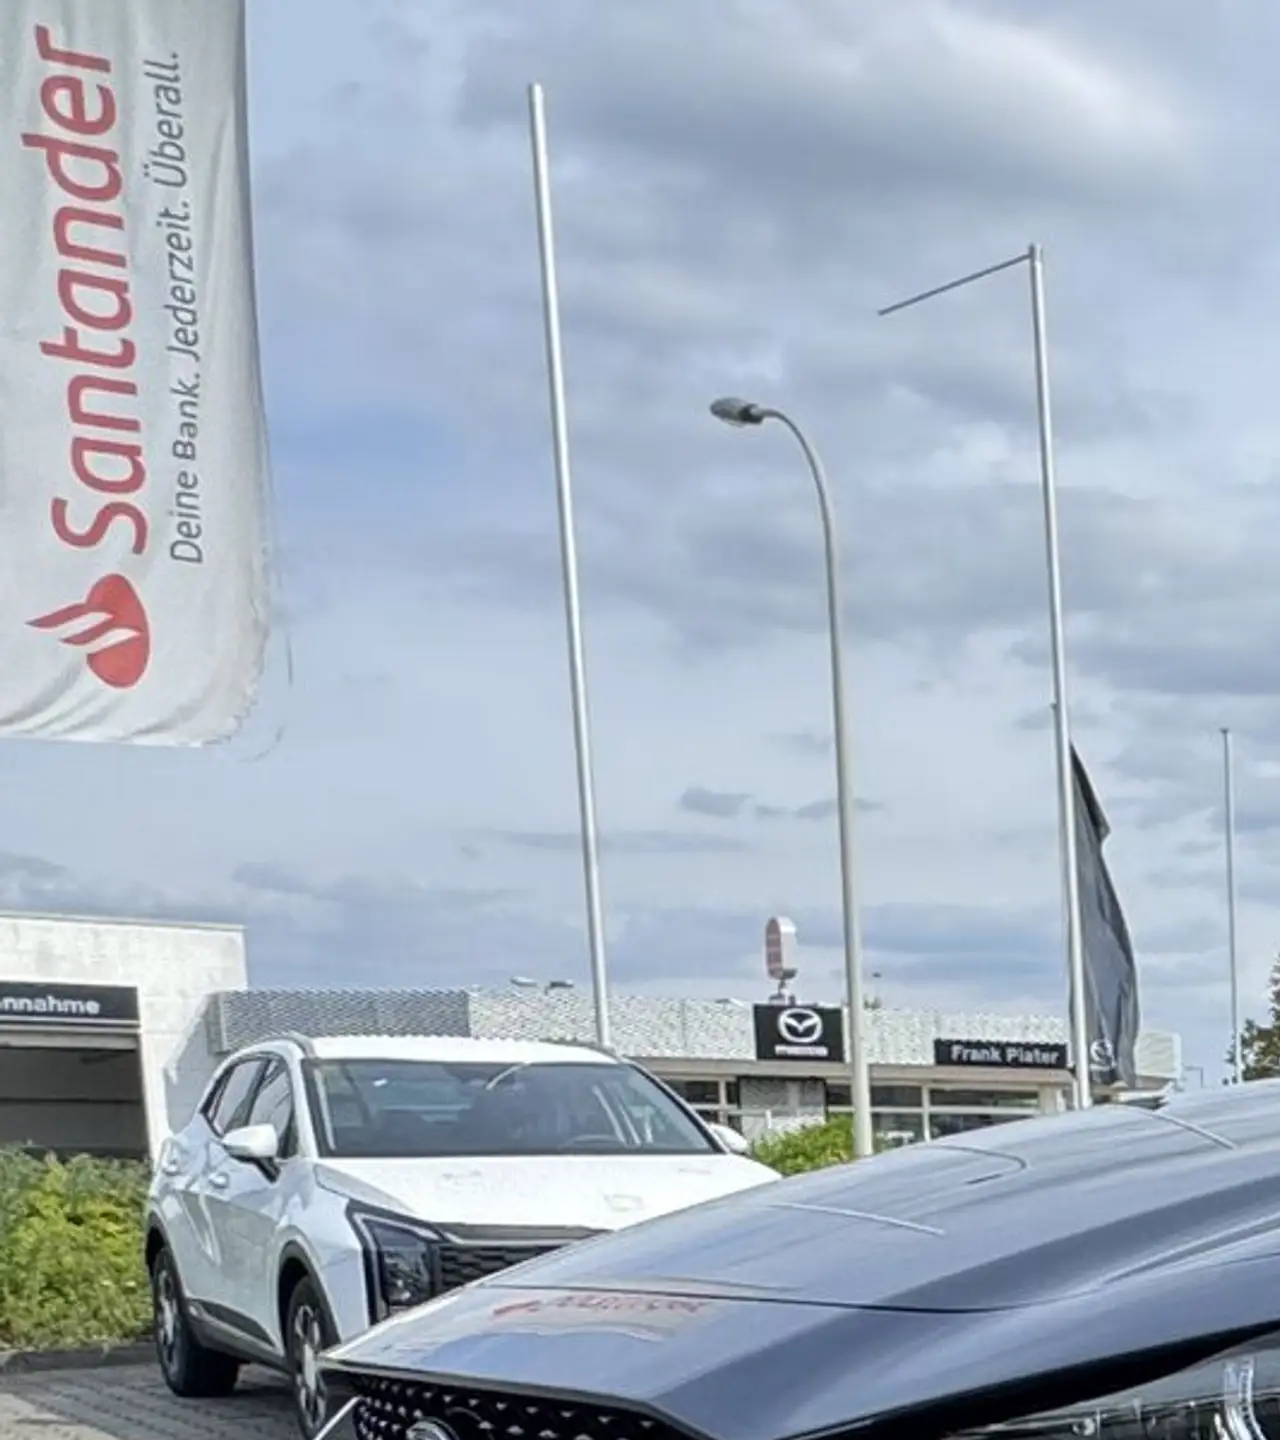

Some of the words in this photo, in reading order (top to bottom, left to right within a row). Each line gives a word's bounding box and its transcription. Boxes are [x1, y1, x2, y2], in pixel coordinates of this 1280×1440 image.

[143, 52, 187, 188] Überall.
[20, 24, 149, 555] Santander
[155, 201, 200, 363] Jederzeit.
[170, 372, 201, 461] Bank.
[168, 470, 204, 565] Deine
[950, 1044, 1002, 1062] Frank
